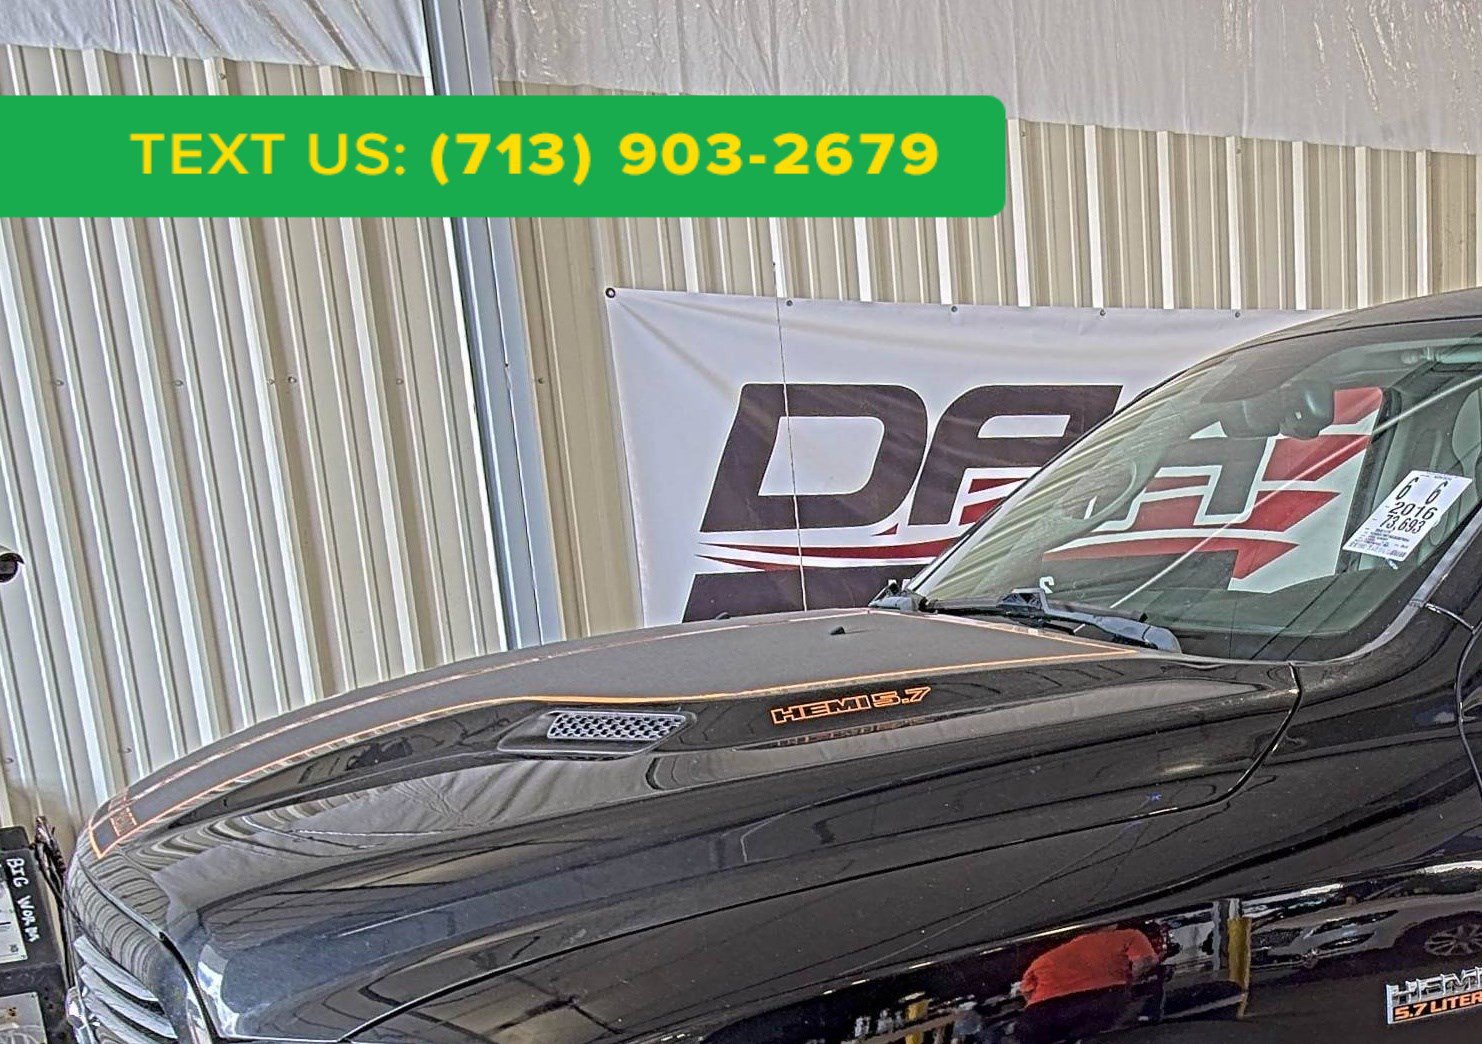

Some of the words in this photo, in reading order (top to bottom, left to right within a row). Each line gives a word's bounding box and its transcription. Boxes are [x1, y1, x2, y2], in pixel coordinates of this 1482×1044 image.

[1394, 476, 1419, 501] 6
[1425, 480, 1448, 506] 6
[1388, 501, 1438, 520] 2016
[771, 694, 871, 725] HEMI
[871, 685, 932, 709] 5.7
[6, 858, 29, 888] BIG
[1394, 1002, 1428, 1021] 5.7
